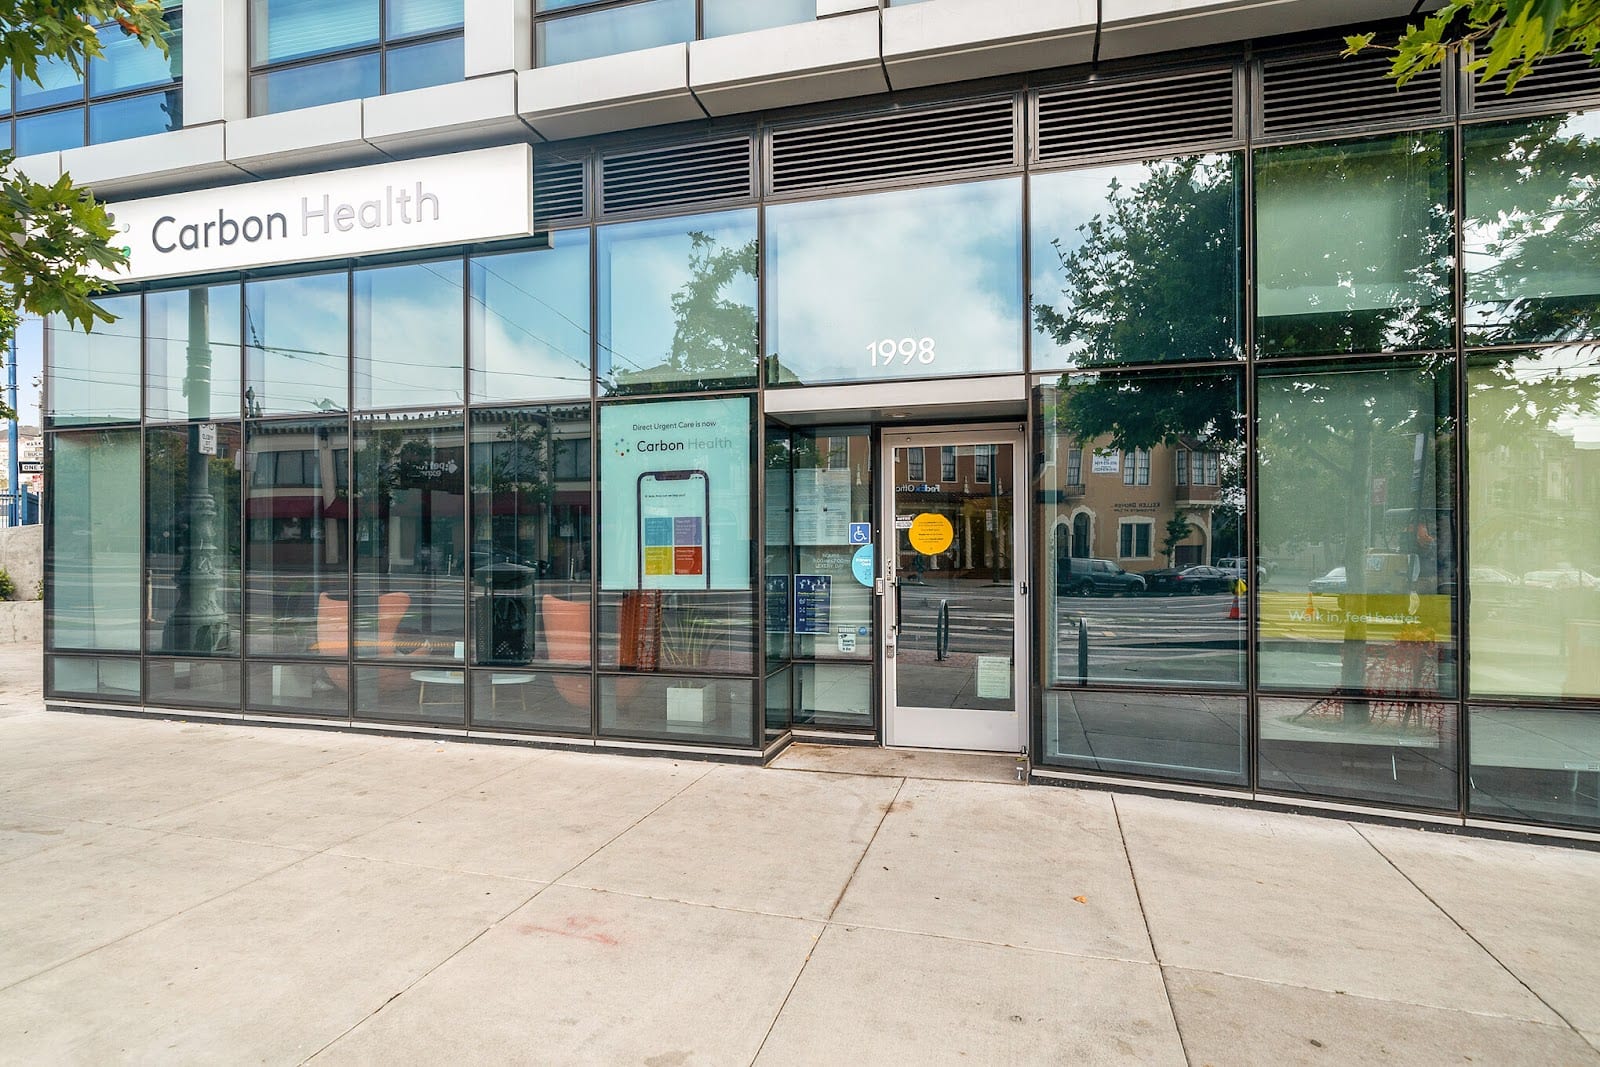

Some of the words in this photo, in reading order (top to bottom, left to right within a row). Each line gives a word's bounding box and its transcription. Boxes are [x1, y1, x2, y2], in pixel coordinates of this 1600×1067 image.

[152, 208, 287, 254] Carbon
[301, 181, 440, 237] Health
[866, 337, 936, 367] 1998
[654, 423, 677, 431] Urgent
[678, 421, 695, 429] Care
[637, 440, 684, 452] Carbon
[687, 437, 733, 450] Health
[1289, 610, 1325, 623] Walk
[1345, 611, 1373, 623] feel
[1375, 612, 1421, 624] better
